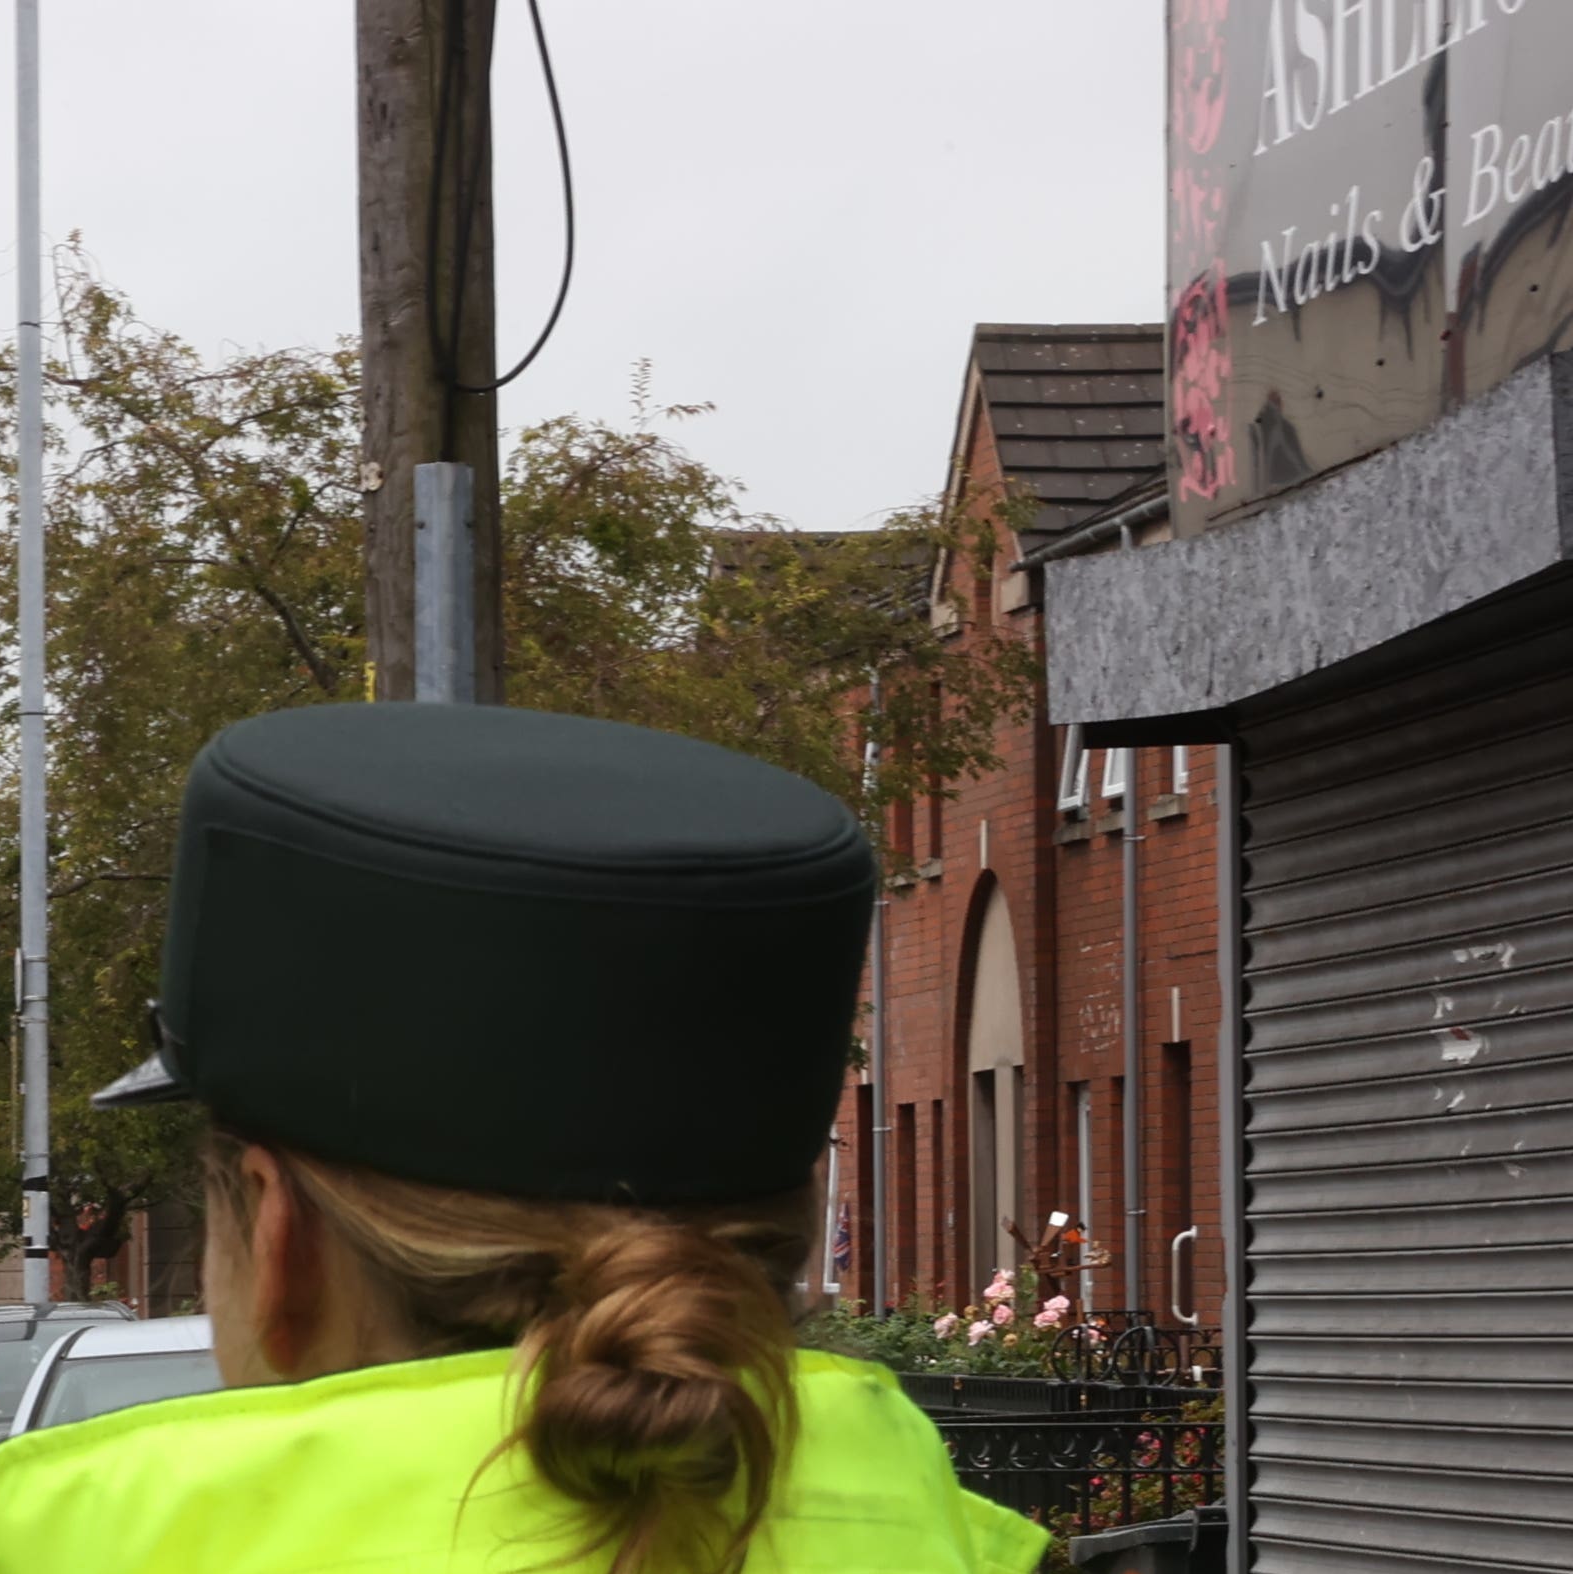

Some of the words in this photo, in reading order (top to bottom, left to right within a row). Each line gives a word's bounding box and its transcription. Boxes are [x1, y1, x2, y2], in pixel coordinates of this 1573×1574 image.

[1252, 184, 1383, 327] Nails
[1399, 156, 1449, 253] &
[1461, 107, 1573, 228] Bea
